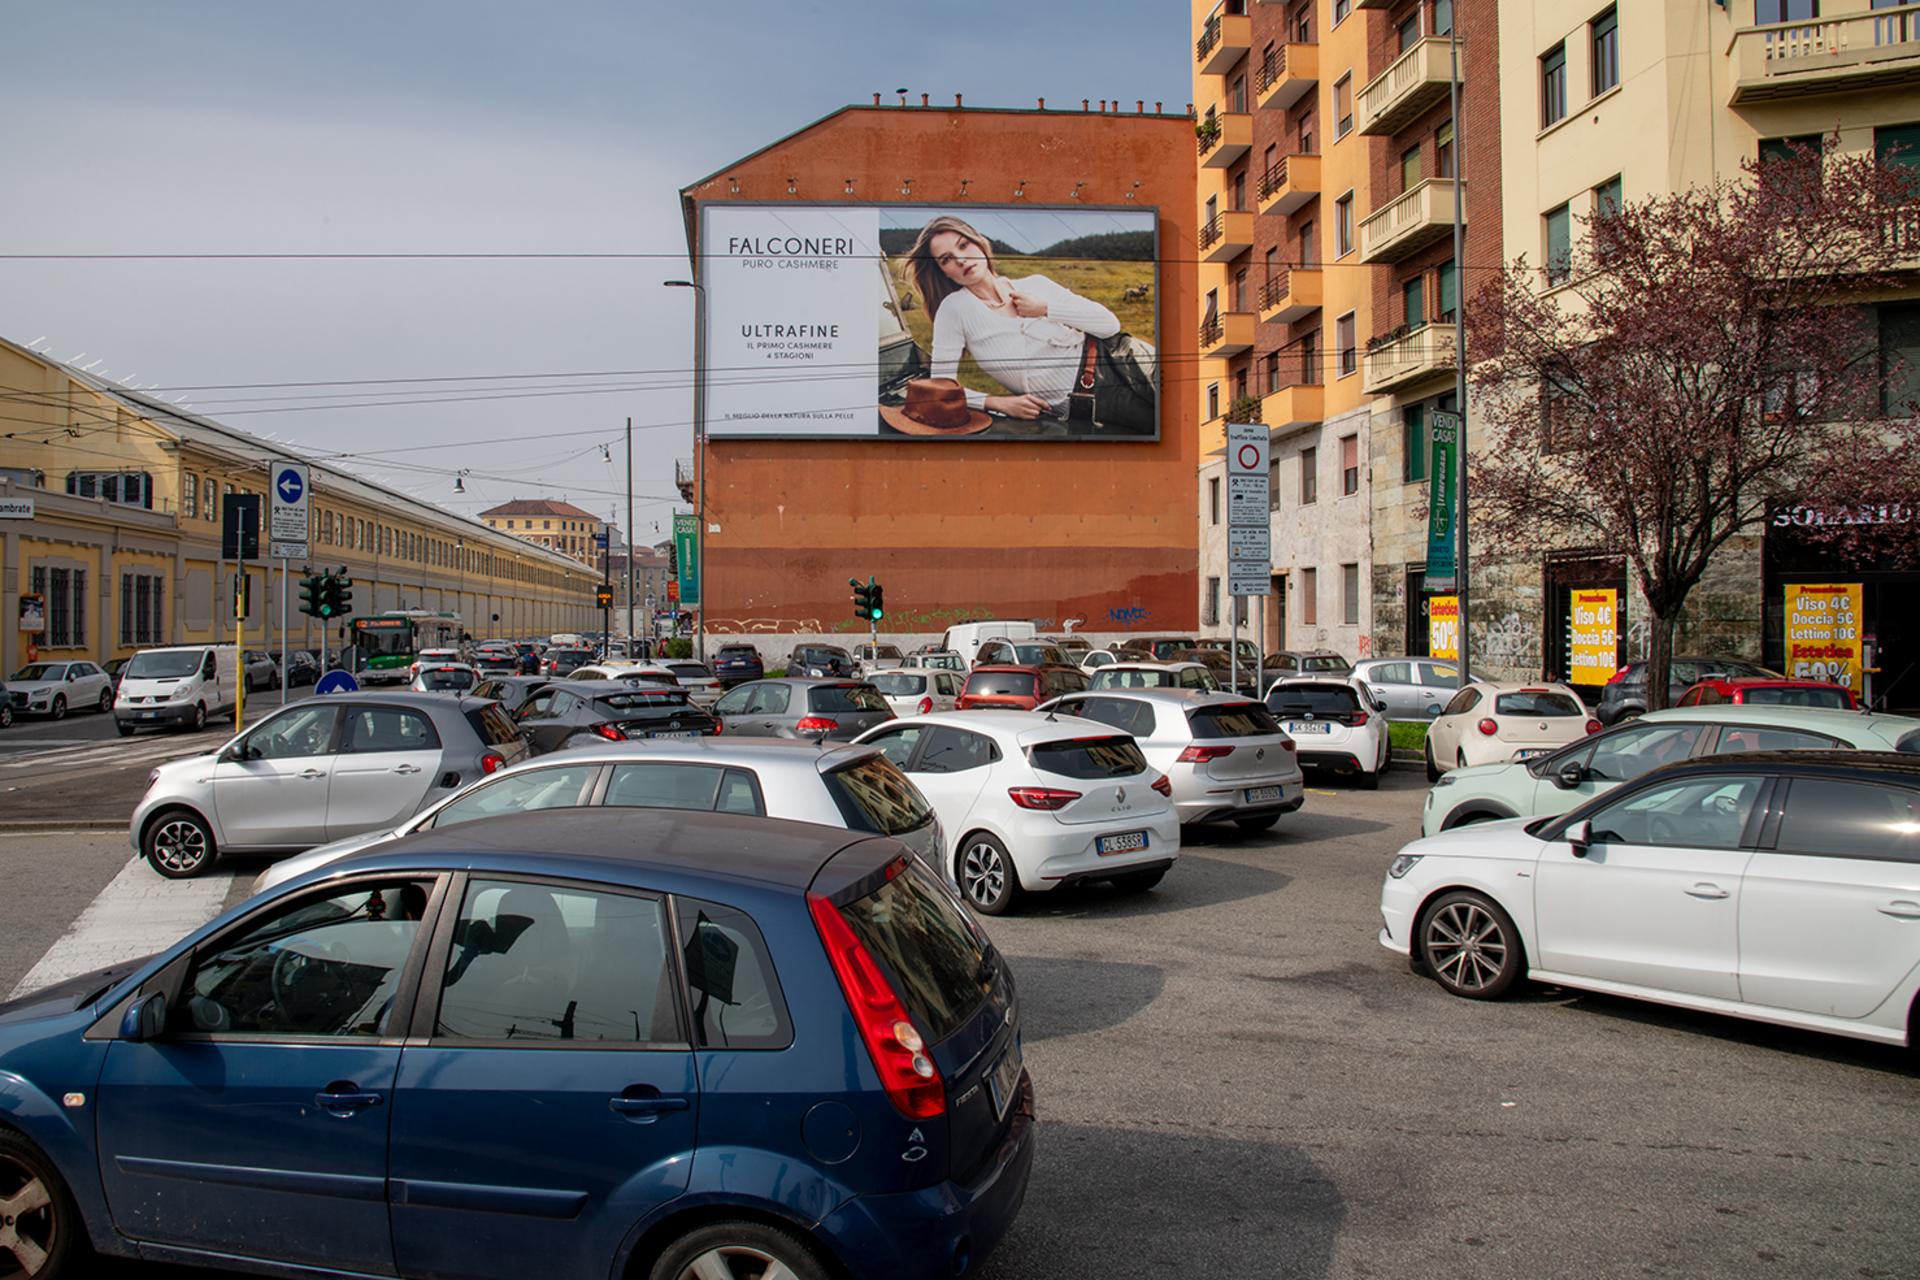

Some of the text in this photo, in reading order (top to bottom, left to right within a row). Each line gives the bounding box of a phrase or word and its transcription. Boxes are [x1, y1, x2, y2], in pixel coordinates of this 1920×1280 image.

[729, 237, 853, 255] FALCONERI
[742, 259, 839, 270] PURO CASHMERE
[741, 324, 839, 338] ULTRAFINE
[747, 342, 833, 350] IL PRIMO CASHMERE
[774, 352, 814, 360] STAGIONI
[1432, 412, 1456, 430] VENDI
[1432, 428, 1456, 443] CASA?
[1773, 503, 1920, 527] SOLARIU
[1796, 596, 1850, 611] Viso 4€
[1574, 605, 1595, 625] Viso
[1597, 605, 1611, 625] 4€
[1792, 612, 1854, 625] Doccia 5€
[1432, 620, 1459, 651] 50%
[1571, 628, 1614, 646] Doccia 5€
[1790, 627, 1856, 640] Lettino 10€
[1792, 643, 1854, 658] Estetica
[1571, 650, 1615, 668] Lettino 10€
[1794, 661, 1852, 688] 50%
